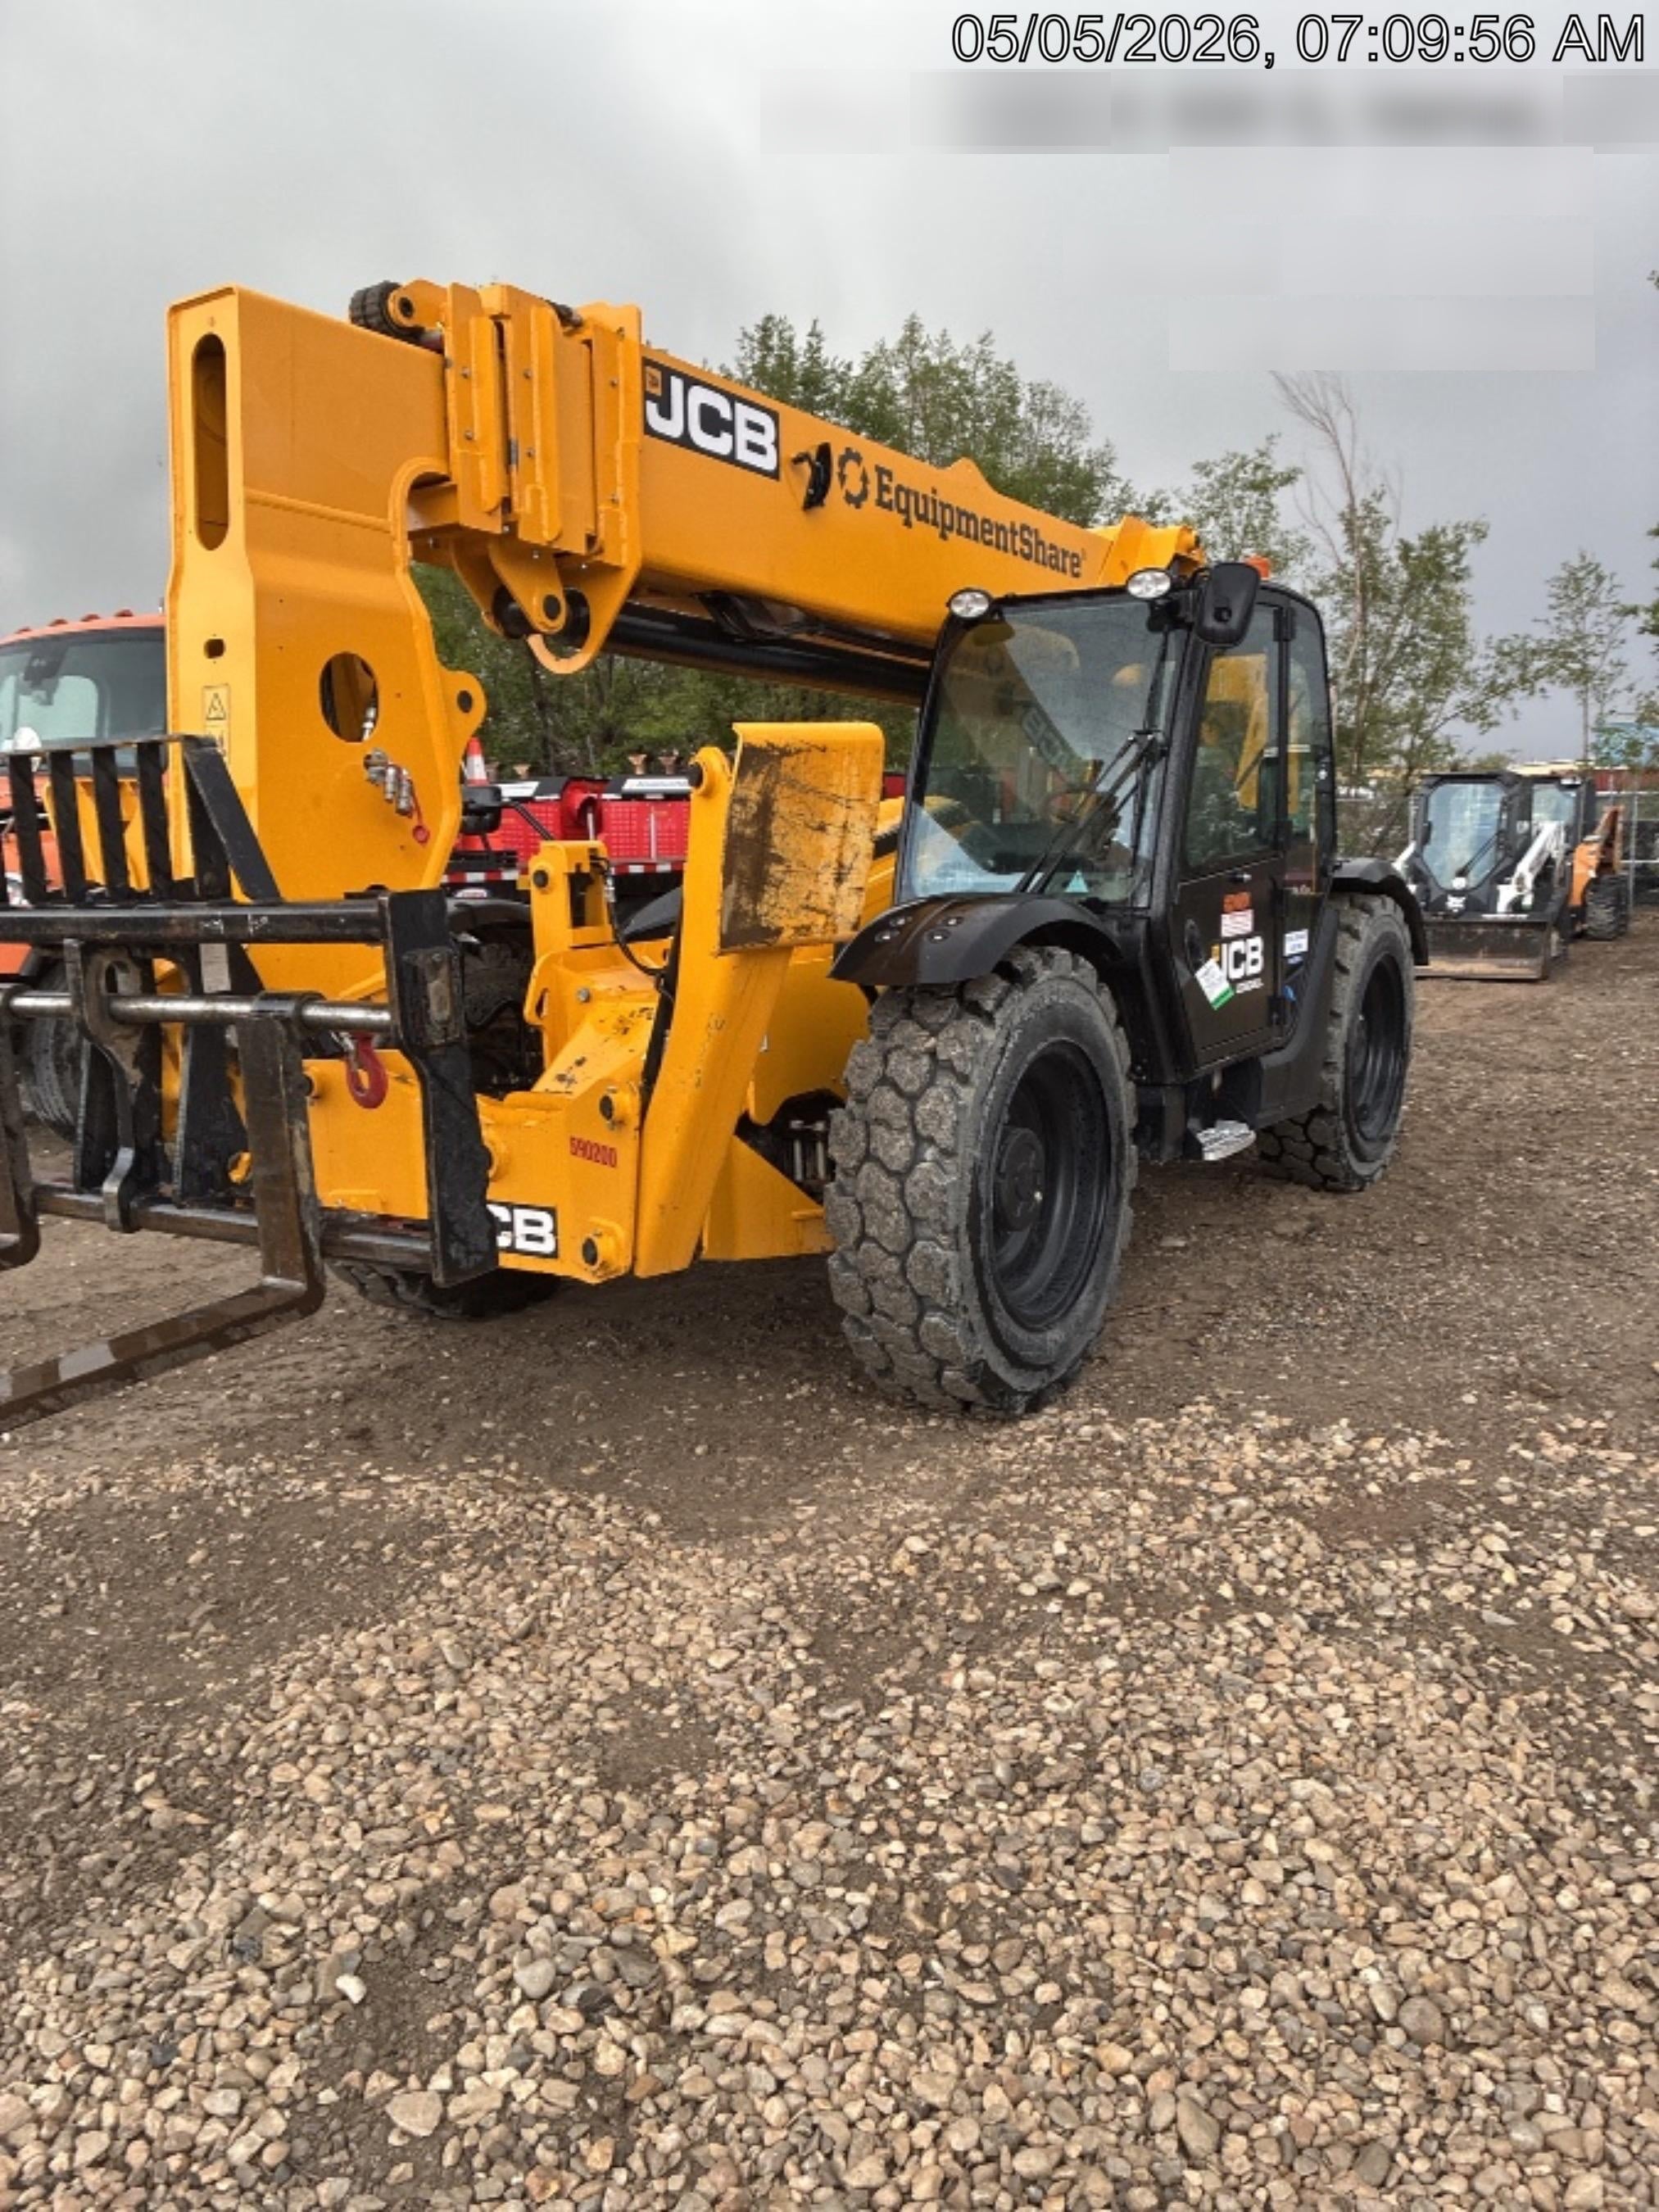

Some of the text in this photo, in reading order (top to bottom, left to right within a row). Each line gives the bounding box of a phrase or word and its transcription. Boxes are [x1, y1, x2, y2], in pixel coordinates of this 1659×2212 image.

[645, 374, 778, 473] JCB
[874, 465, 1083, 578] EquipmentShare
[485, 1203, 556, 1254] CB
